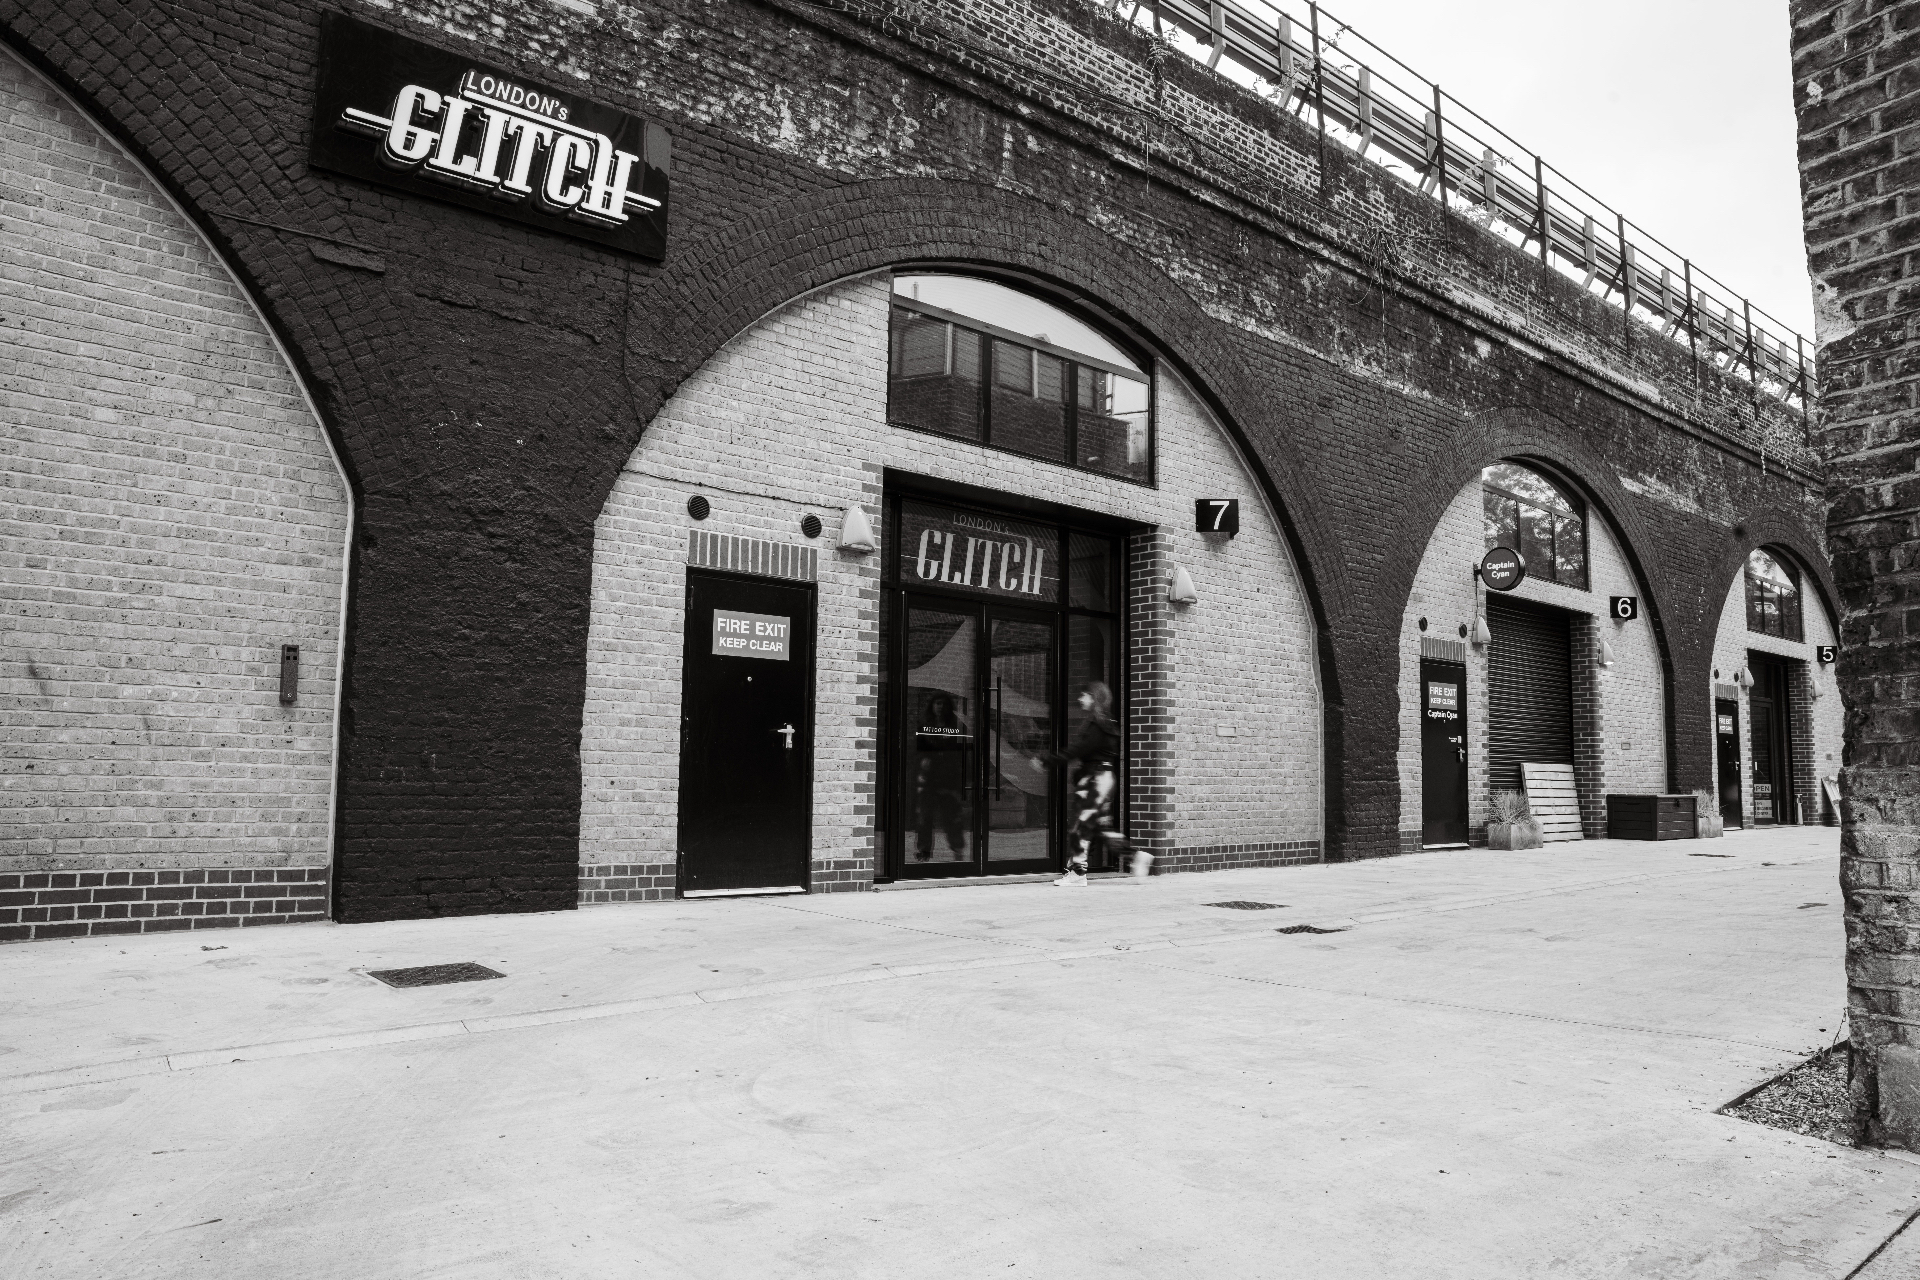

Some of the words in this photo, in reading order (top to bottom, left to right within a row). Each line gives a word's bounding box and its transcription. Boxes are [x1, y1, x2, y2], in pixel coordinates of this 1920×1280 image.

[386, 84, 640, 224] GLITCH
[1209, 500, 1230, 530] 7
[916, 528, 1046, 596] GLITCH
[1486, 561, 1515, 571] Captain
[1491, 570, 1510, 579] Cyan
[1617, 598, 1632, 617] 6
[717, 617, 750, 634] FIRE
[755, 621, 787, 637] EXIT
[719, 636, 747, 648] KEEP
[749, 639, 783, 652] CLEAR
[1822, 646, 1834, 662] 5
[1429, 686, 1443, 696] FIRE
[1443, 687, 1457, 697] EXIT
[1442, 698, 1456, 706] CLEAR
[1427, 709, 1447, 719] Captain
